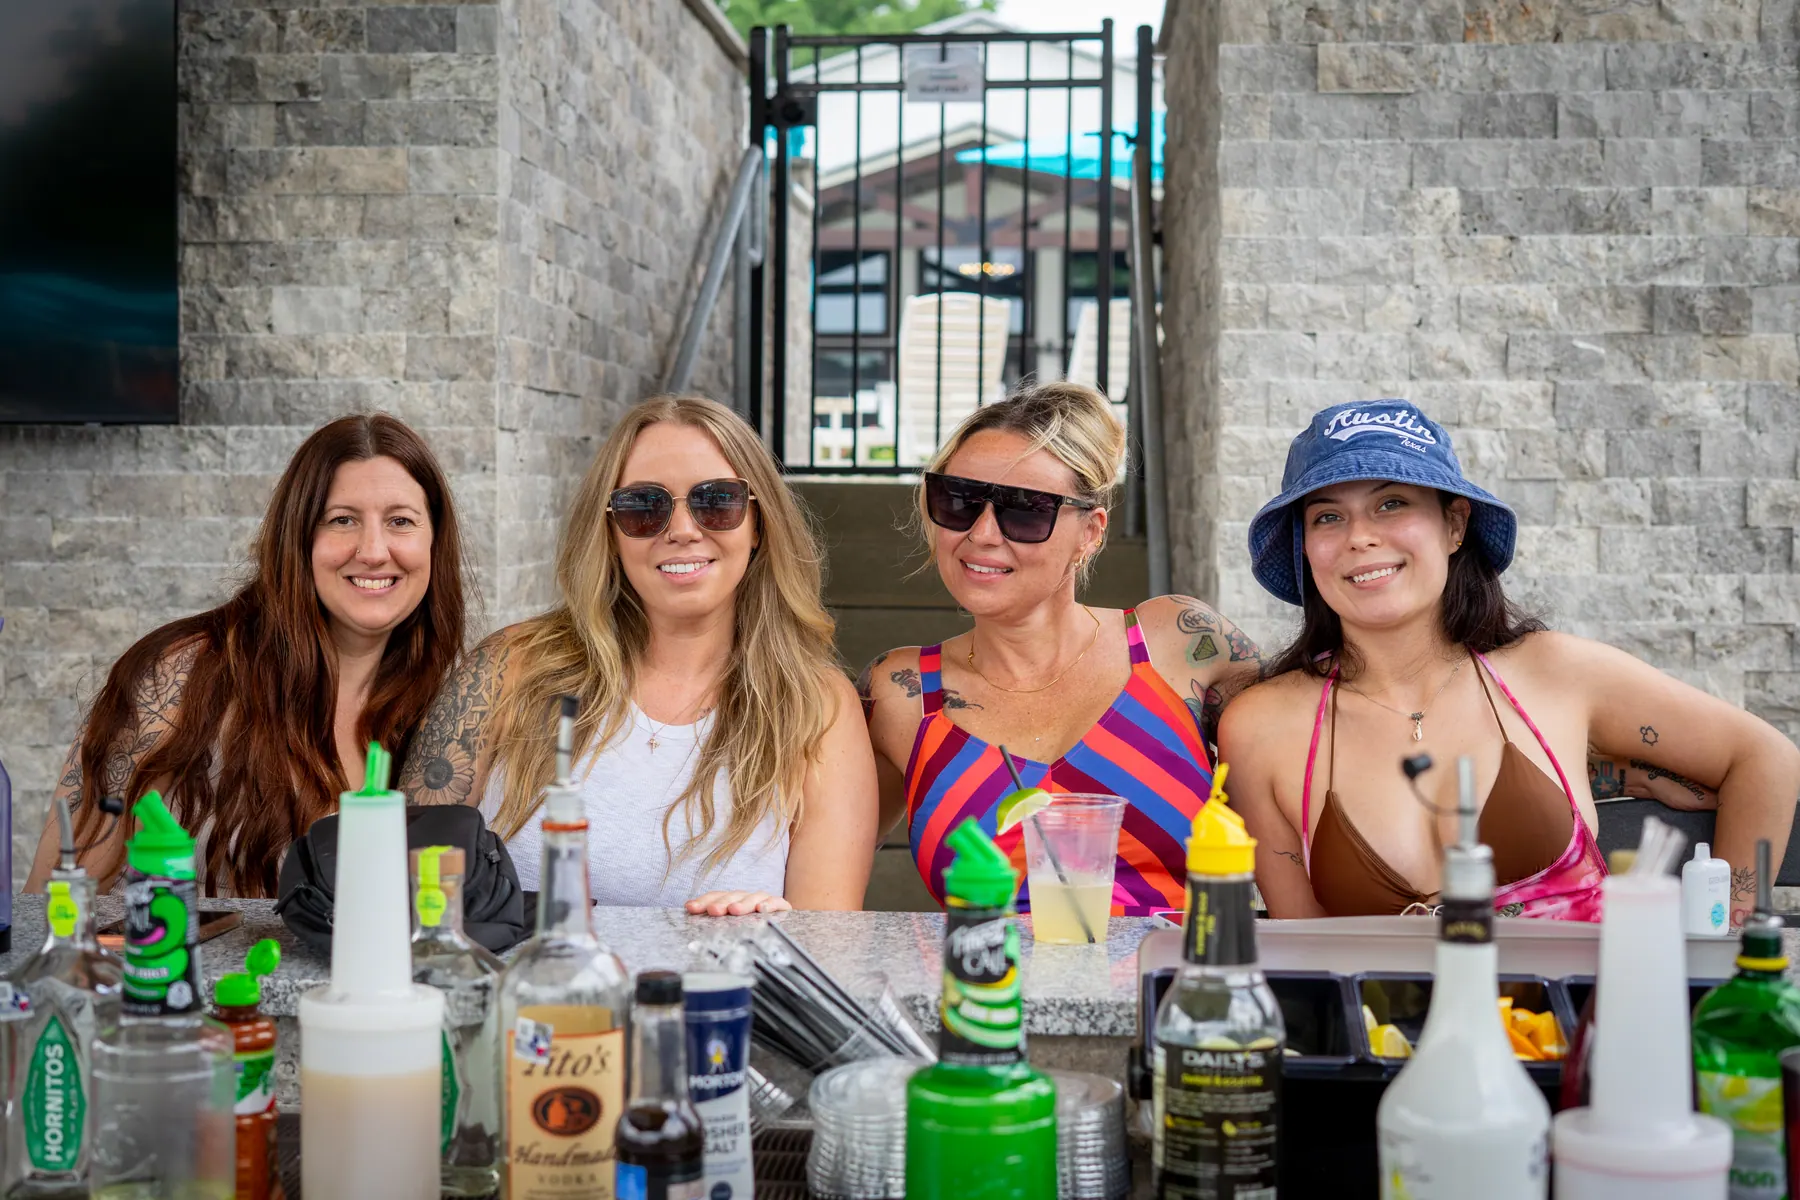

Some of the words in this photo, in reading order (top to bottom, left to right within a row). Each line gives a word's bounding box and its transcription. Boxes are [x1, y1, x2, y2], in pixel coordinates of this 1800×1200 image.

[1324, 408, 1435, 440] Austin
[1398, 435, 1427, 453] Texas
[1182, 1049, 1265, 1072] DAILY'S
[44, 1043, 64, 1163] HORNITOS
